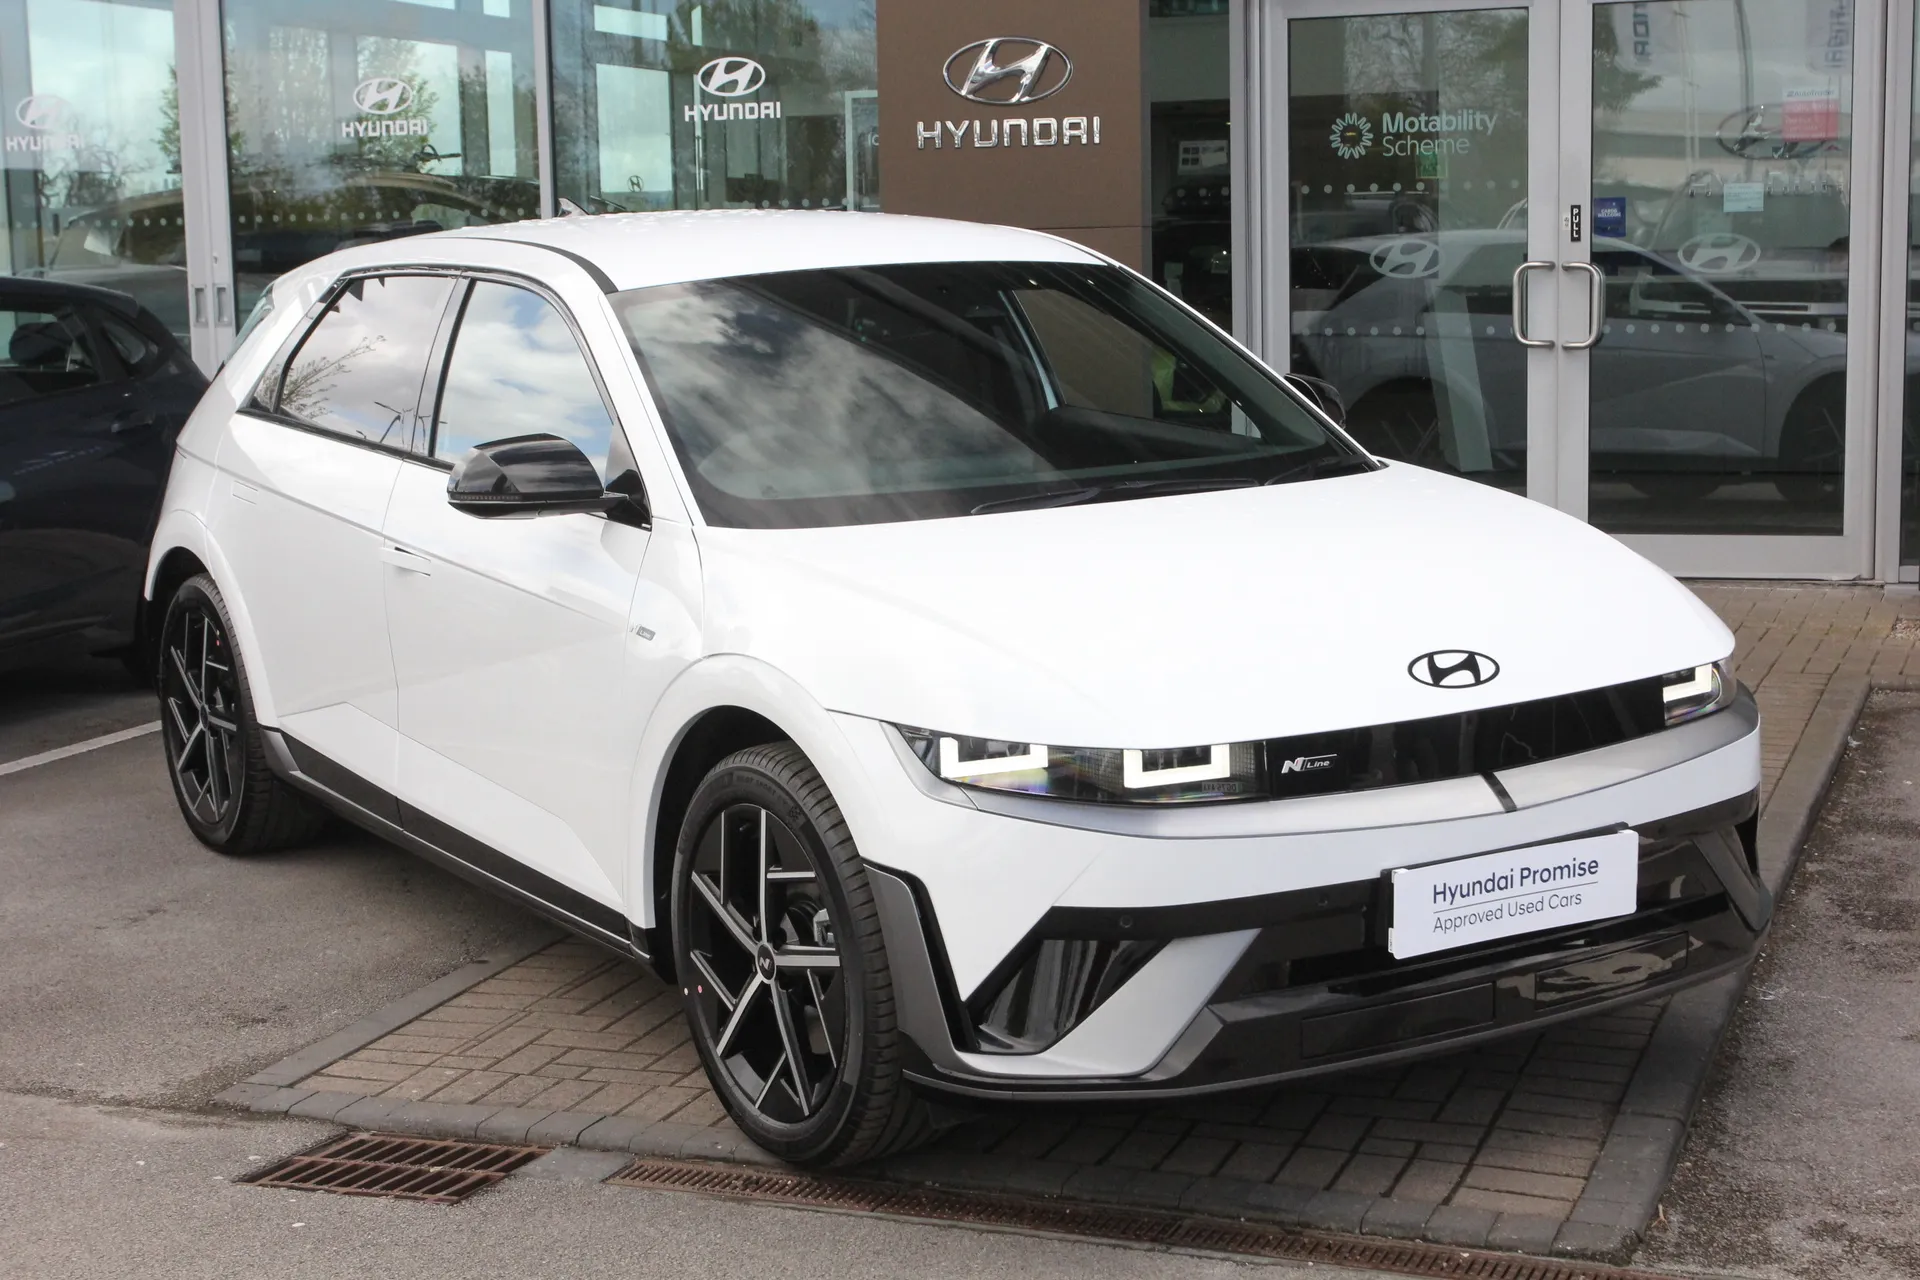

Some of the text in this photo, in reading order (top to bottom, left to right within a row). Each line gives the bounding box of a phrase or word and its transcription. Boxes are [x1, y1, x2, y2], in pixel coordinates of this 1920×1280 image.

[683, 101, 781, 122] HYUNDAI
[1382, 109, 1498, 136] Motability
[341, 117, 428, 138] HYUNDAI
[916, 115, 1101, 149] HYUNDAI
[5, 134, 85, 152] HYUNAI
[1382, 135, 1470, 157] Scheme
[1306, 760, 1330, 769] Line
[1433, 857, 1599, 905] Hyundai Promise
[1433, 892, 1582, 934] Approved Used Cars
